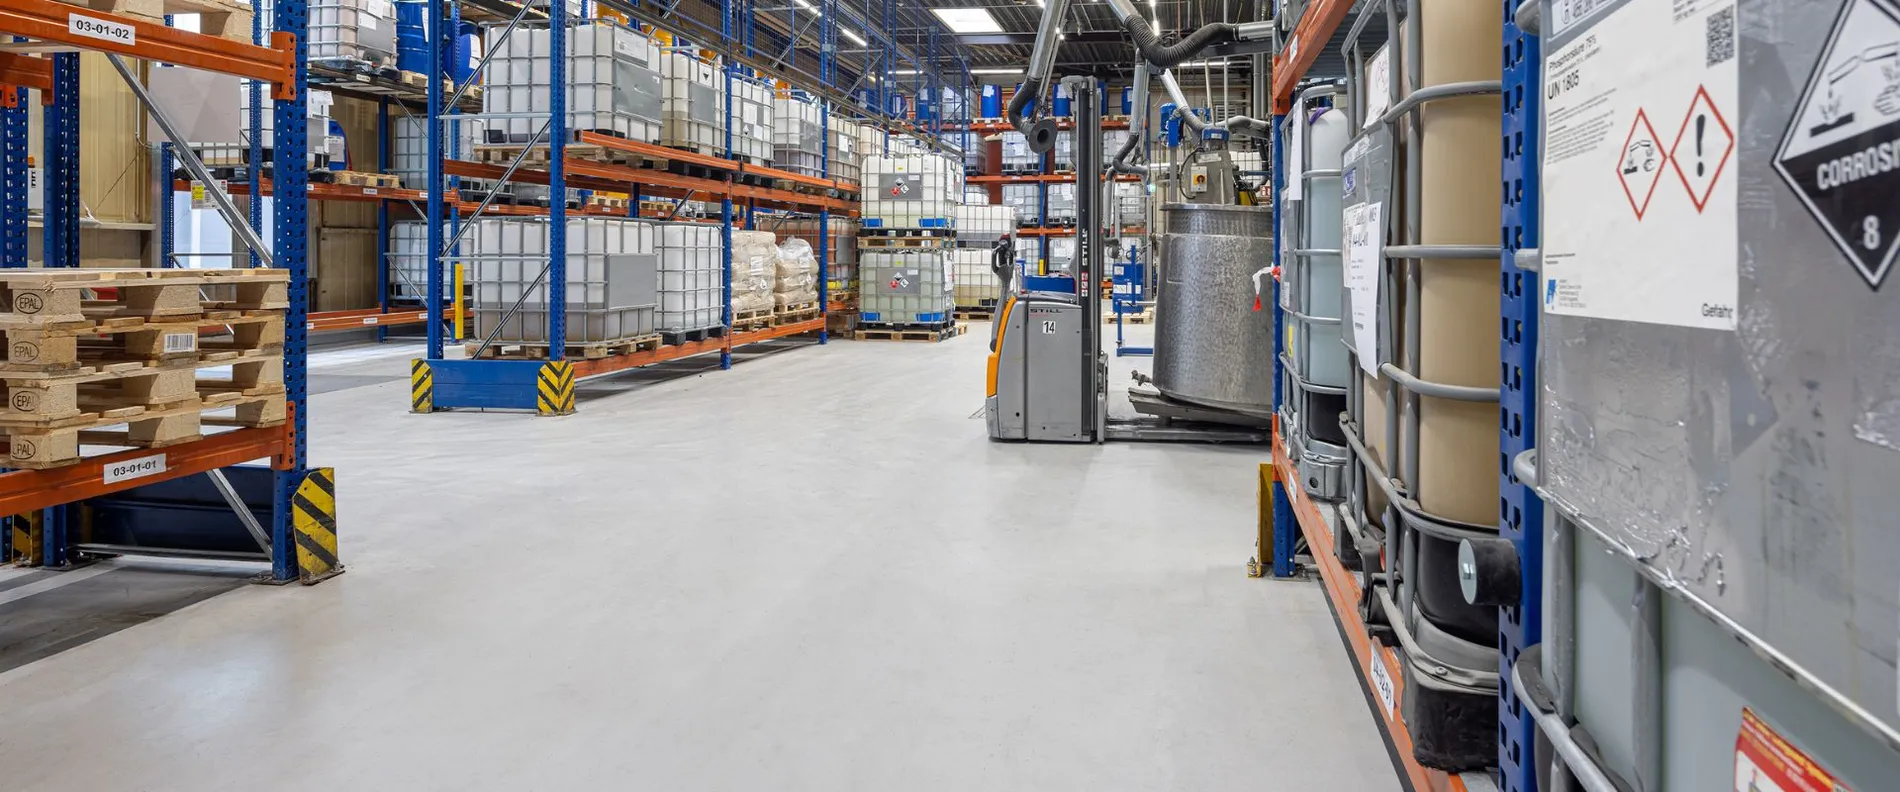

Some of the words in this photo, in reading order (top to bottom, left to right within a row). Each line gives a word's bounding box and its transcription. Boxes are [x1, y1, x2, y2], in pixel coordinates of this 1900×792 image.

[76, 19, 129, 39] 03-01-02
[1547, 80, 1560, 100] UN
[1562, 69, 1580, 93] 1805
[1816, 138, 1900, 190] CORROSI
[1863, 215, 1880, 249] 8
[20, 297, 39, 310] EPAL
[1702, 303, 1733, 319] Gefahr
[1044, 321, 1055, 333] 14
[14, 346, 34, 358] EPAL
[113, 460, 156, 477] 03-01-01
